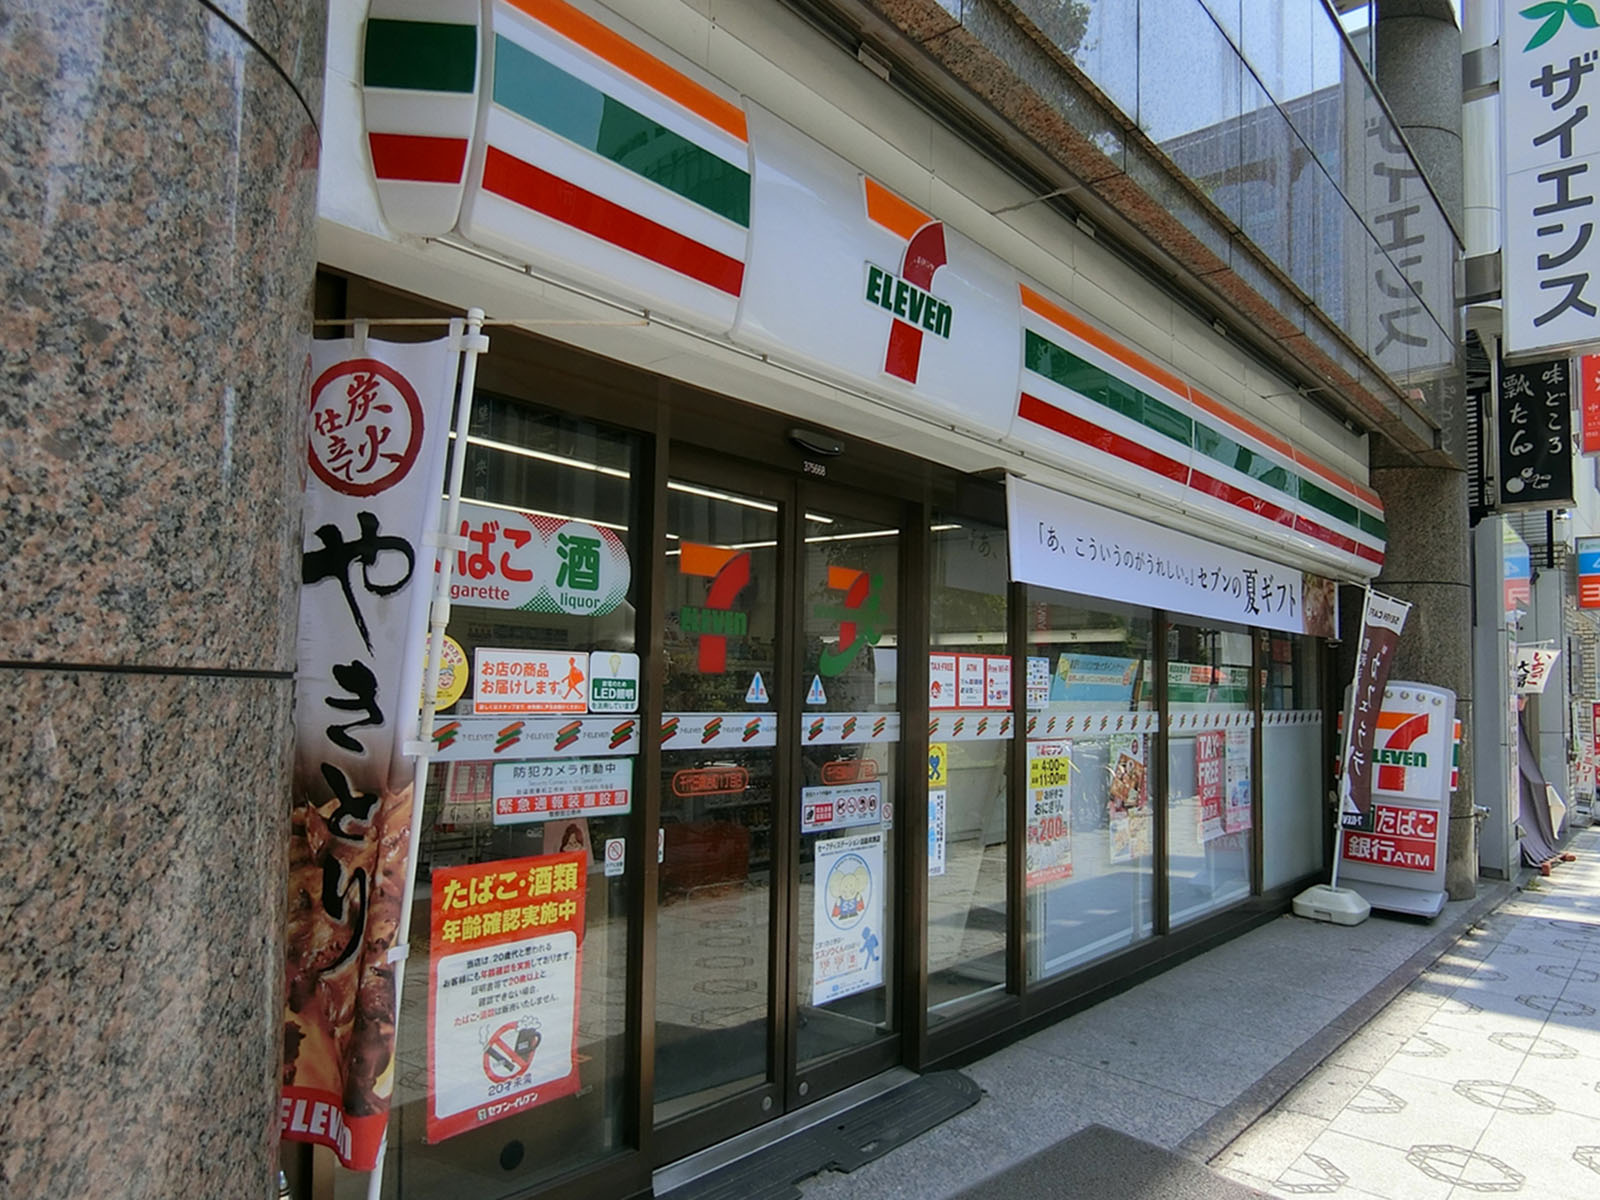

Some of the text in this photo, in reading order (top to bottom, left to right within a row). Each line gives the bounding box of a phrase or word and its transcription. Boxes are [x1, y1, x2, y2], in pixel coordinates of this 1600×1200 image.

[1530, 50, 1597, 328] ザイエンス
[864, 176, 947, 385] 7
[346, 373, 407, 473] 炭火
[1542, 363, 1566, 454] 味どころ
[314, 408, 354, 482] 仕立て
[436, 520, 533, 582] ばこ
[556, 532, 601, 592] 酒
[450, 585, 510, 601] garette
[560, 592, 601, 609] liquor
[481, 661, 549, 678] お店の商品
[481, 679, 562, 695] お届けします。
[593, 687, 635, 700] LED照明
[302, 511, 415, 974] やきとり
[513, 763, 616, 779] 防犯カメラ作動中
[498, 791, 626, 814] 緊急通報装置設置
[1377, 807, 1435, 838] たばこ
[1348, 835, 1430, 867] 銀行ATM
[442, 861, 578, 911] たばこ・酒類
[441, 898, 577, 944] 年齢確認実施中
